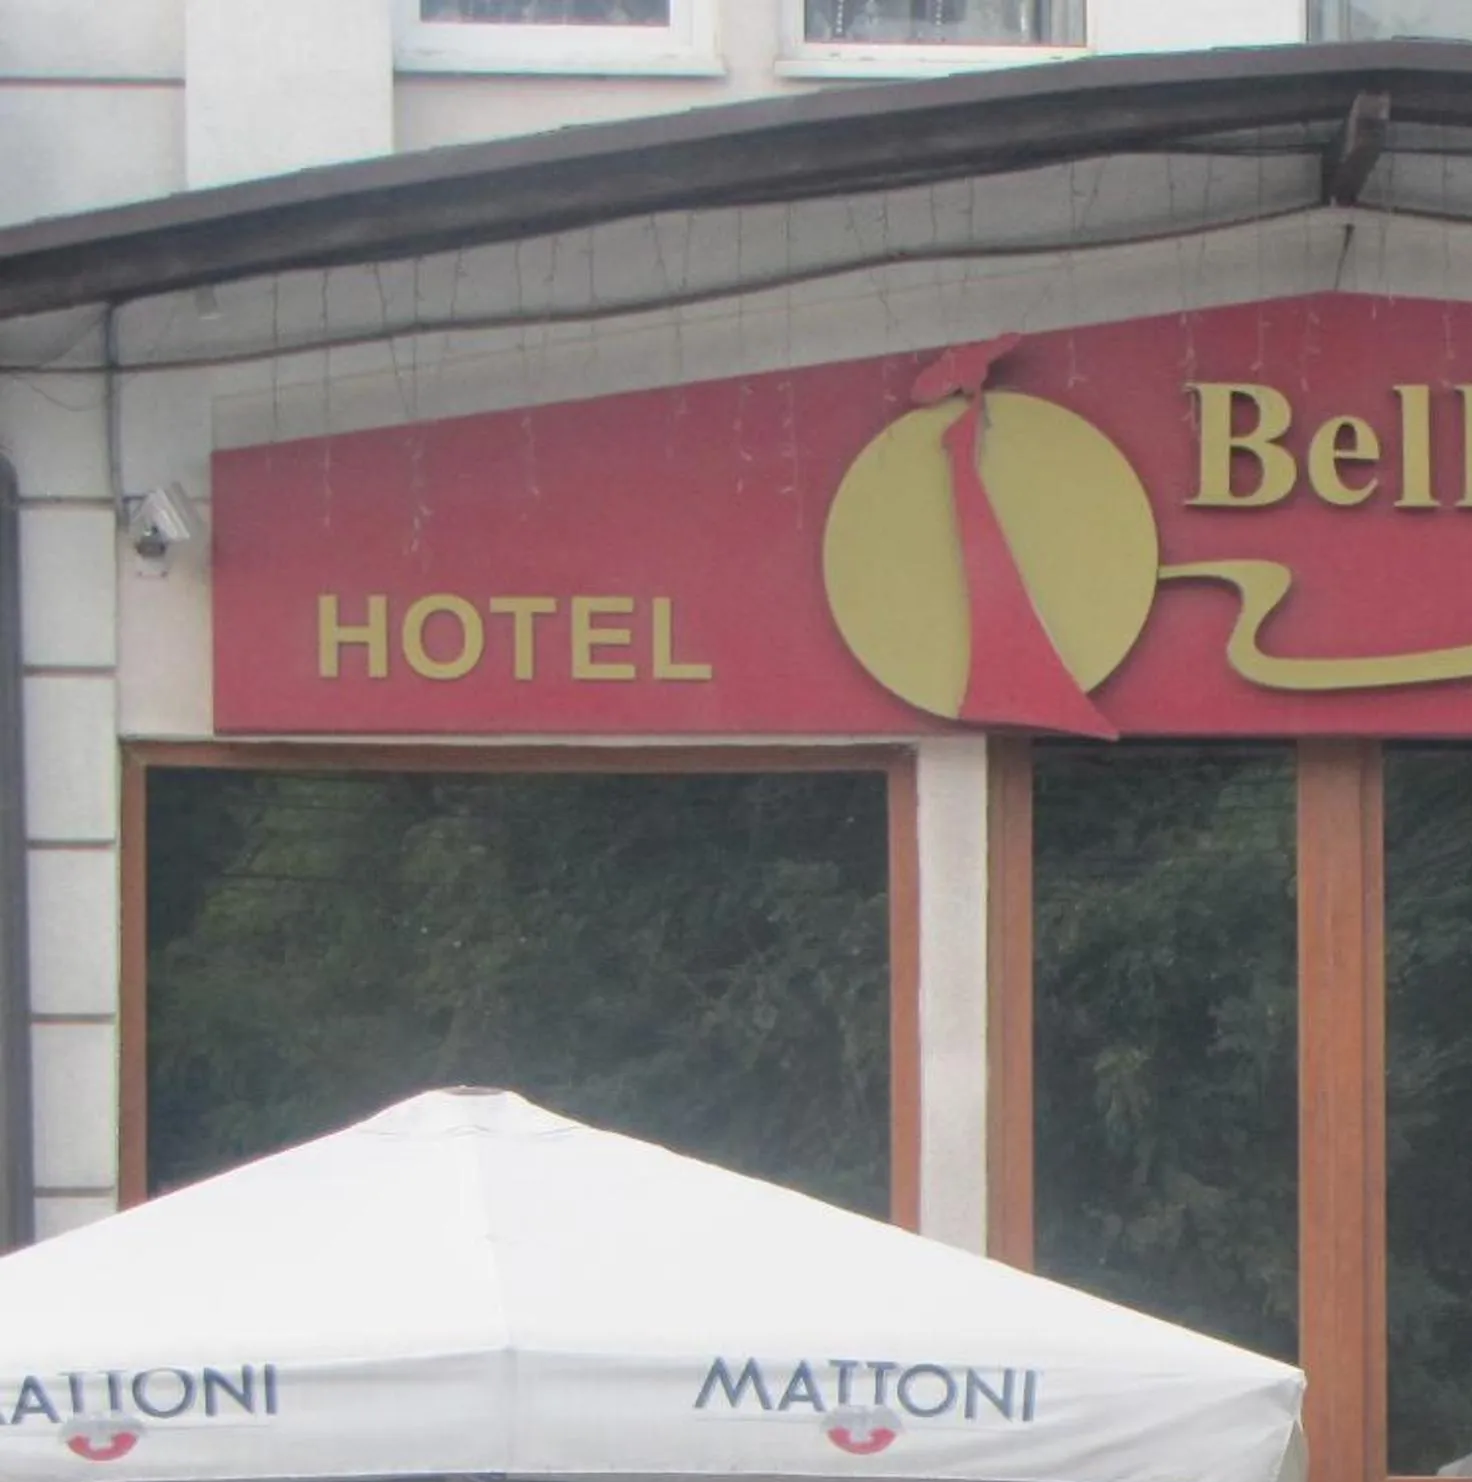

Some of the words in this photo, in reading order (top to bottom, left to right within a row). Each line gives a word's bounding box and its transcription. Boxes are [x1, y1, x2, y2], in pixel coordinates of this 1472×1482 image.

[317, 593, 714, 682] HOTEL
[0, 1364, 278, 1424] ATTONI
[694, 1356, 1038, 1422] MATTONI
